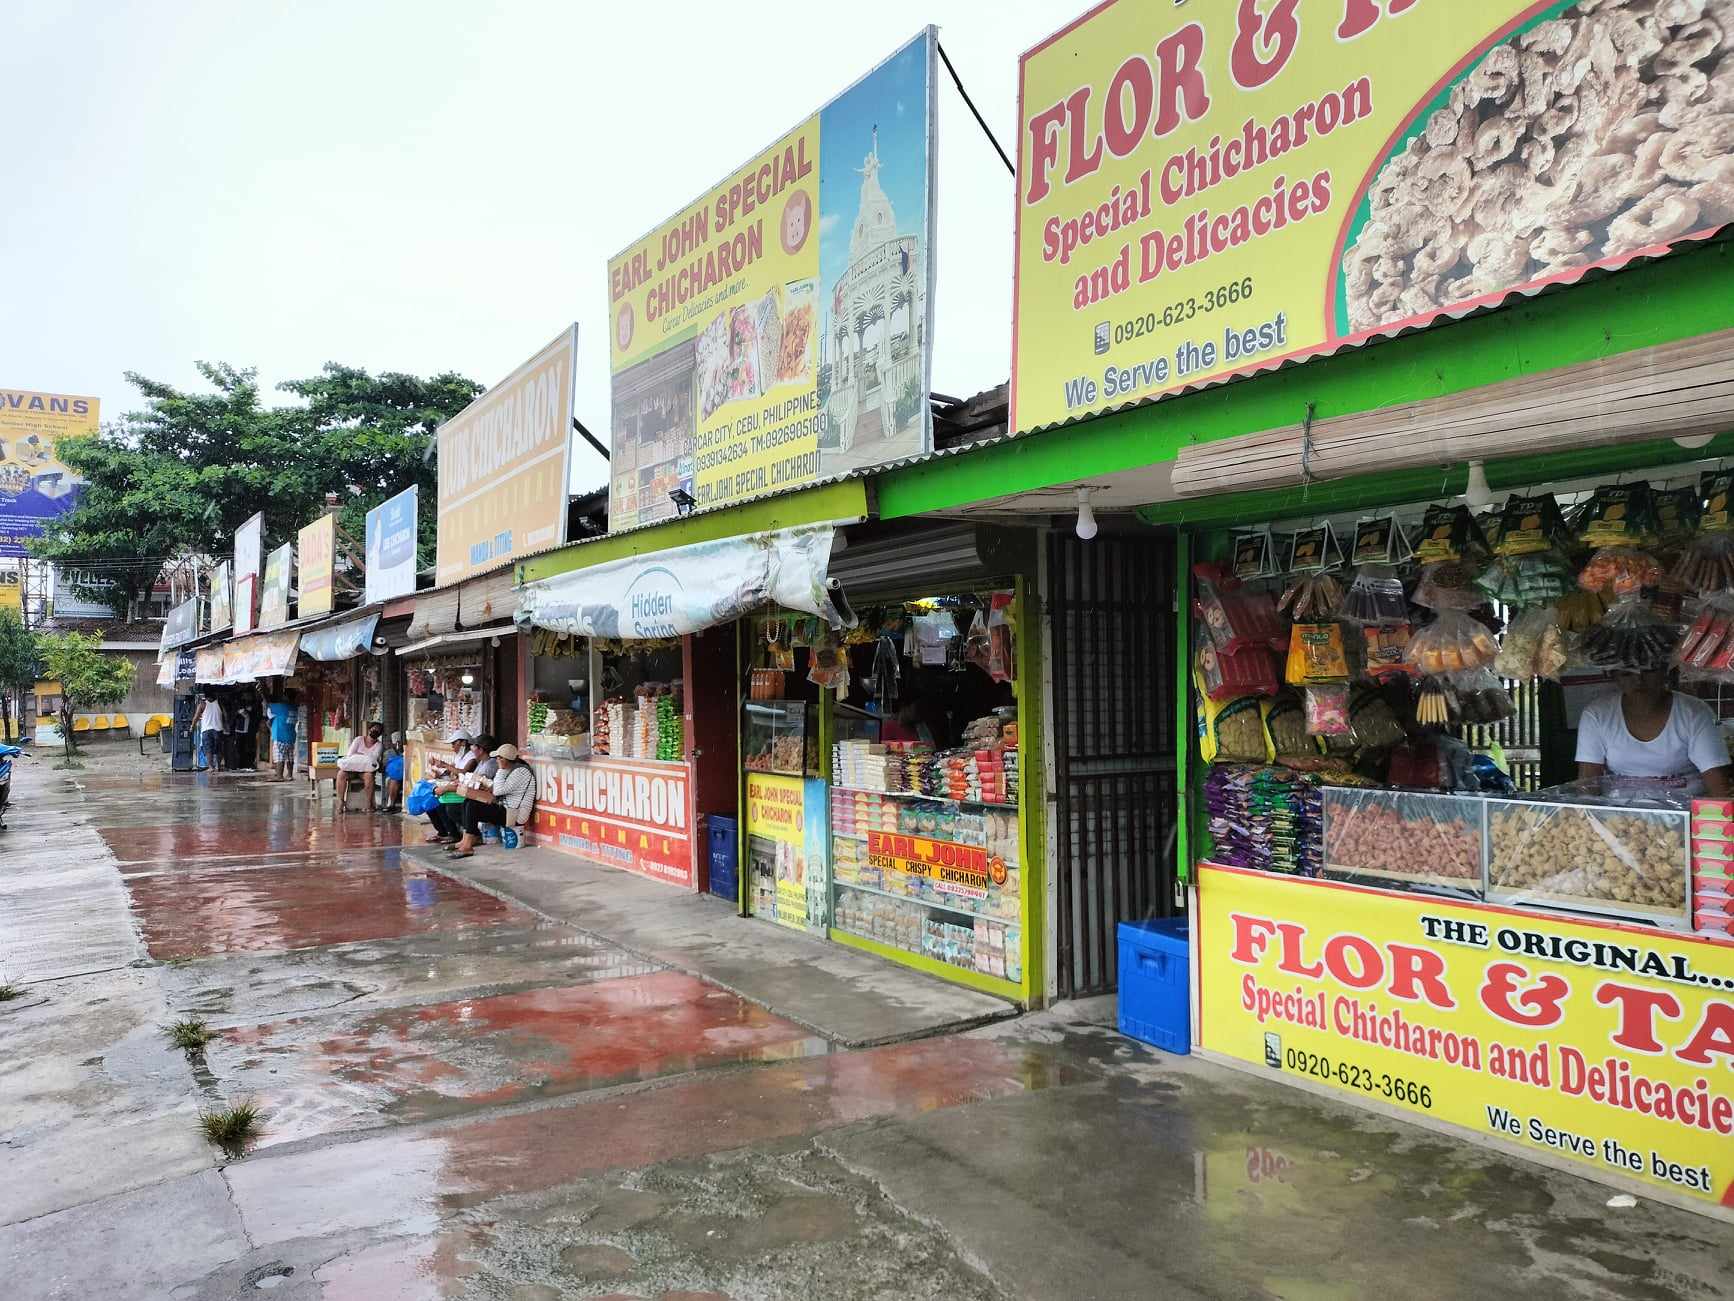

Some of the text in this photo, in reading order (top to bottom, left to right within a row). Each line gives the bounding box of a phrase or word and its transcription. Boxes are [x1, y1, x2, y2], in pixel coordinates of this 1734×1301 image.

[1026, 0, 1298, 205] FLOR &
[1042, 77, 1373, 265] Special Chicharon
[612, 136, 812, 303] EARL JOHN SPECIAL
[1072, 170, 1331, 310] and Delicacies
[646, 218, 763, 322] CHICHARON
[1114, 277, 1253, 345] 0920-623-3666
[1064, 311, 1287, 409] We Serve the best
[762, 388, 822, 427] PHILIPPINES
[735, 464, 769, 495] SPECIAL
[771, 449, 822, 486] CHICHARON
[631, 592, 673, 619] Hidden
[560, 766, 686, 829] CHICHARON
[868, 830, 988, 876] EARL JOHN
[868, 854, 988, 889] SPECIAL CRISPY CHICHARON
[1421, 915, 1489, 946] THE
[1230, 913, 1456, 1009] FLOR
[1480, 962, 1570, 1027] &
[1241, 973, 1328, 1031] Special
[1332, 994, 1482, 1072] Chicharon
[1489, 1042, 1552, 1088] and
[1286, 1047, 1433, 1109] 0920-623-3666
[1486, 1105, 1712, 1192] We Serve the best
